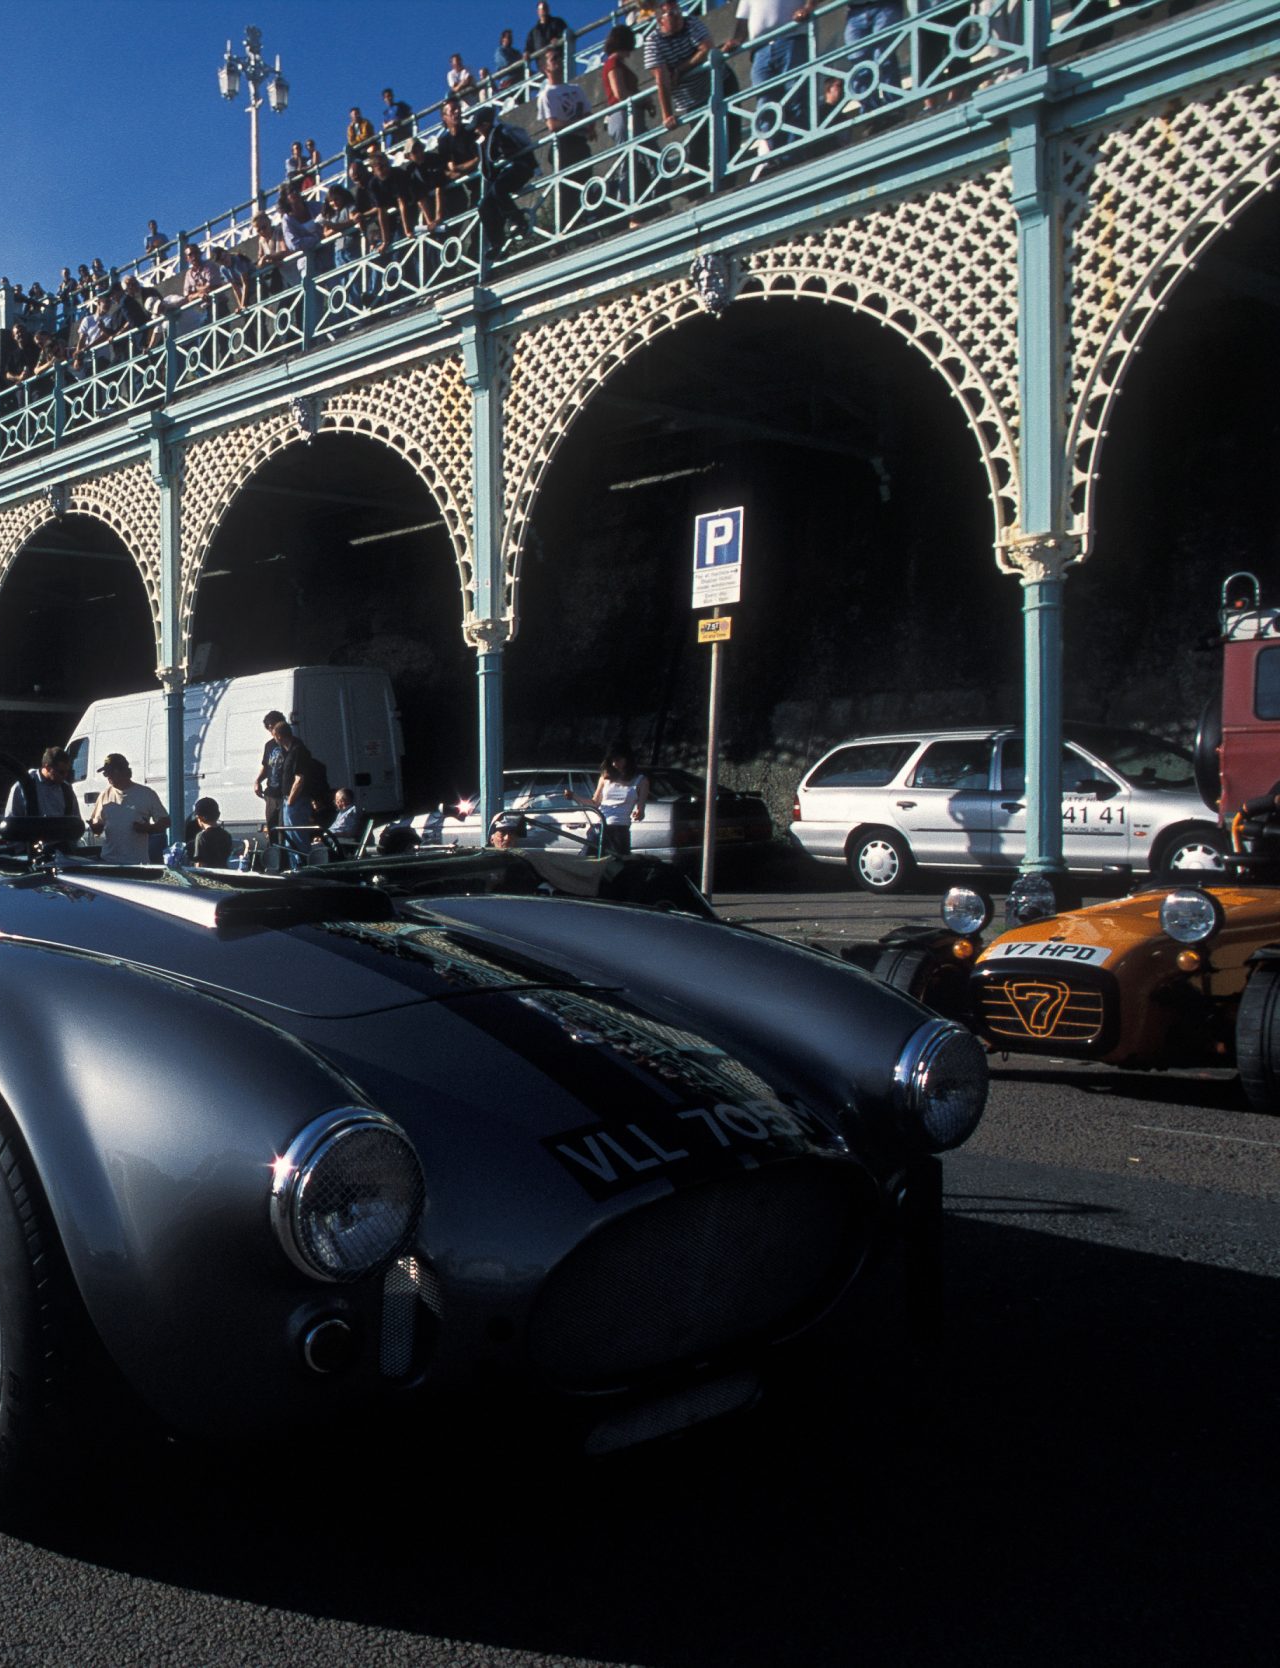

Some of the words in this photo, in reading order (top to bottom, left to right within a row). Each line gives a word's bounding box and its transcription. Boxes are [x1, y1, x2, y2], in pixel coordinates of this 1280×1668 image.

[705, 517, 733, 565] P
[1062, 805, 1087, 824] 41
[1099, 805, 1125, 825] 41
[1003, 943, 1037, 956] V7
[1038, 944, 1097, 961] HPD
[555, 1123, 690, 1183] VLL
